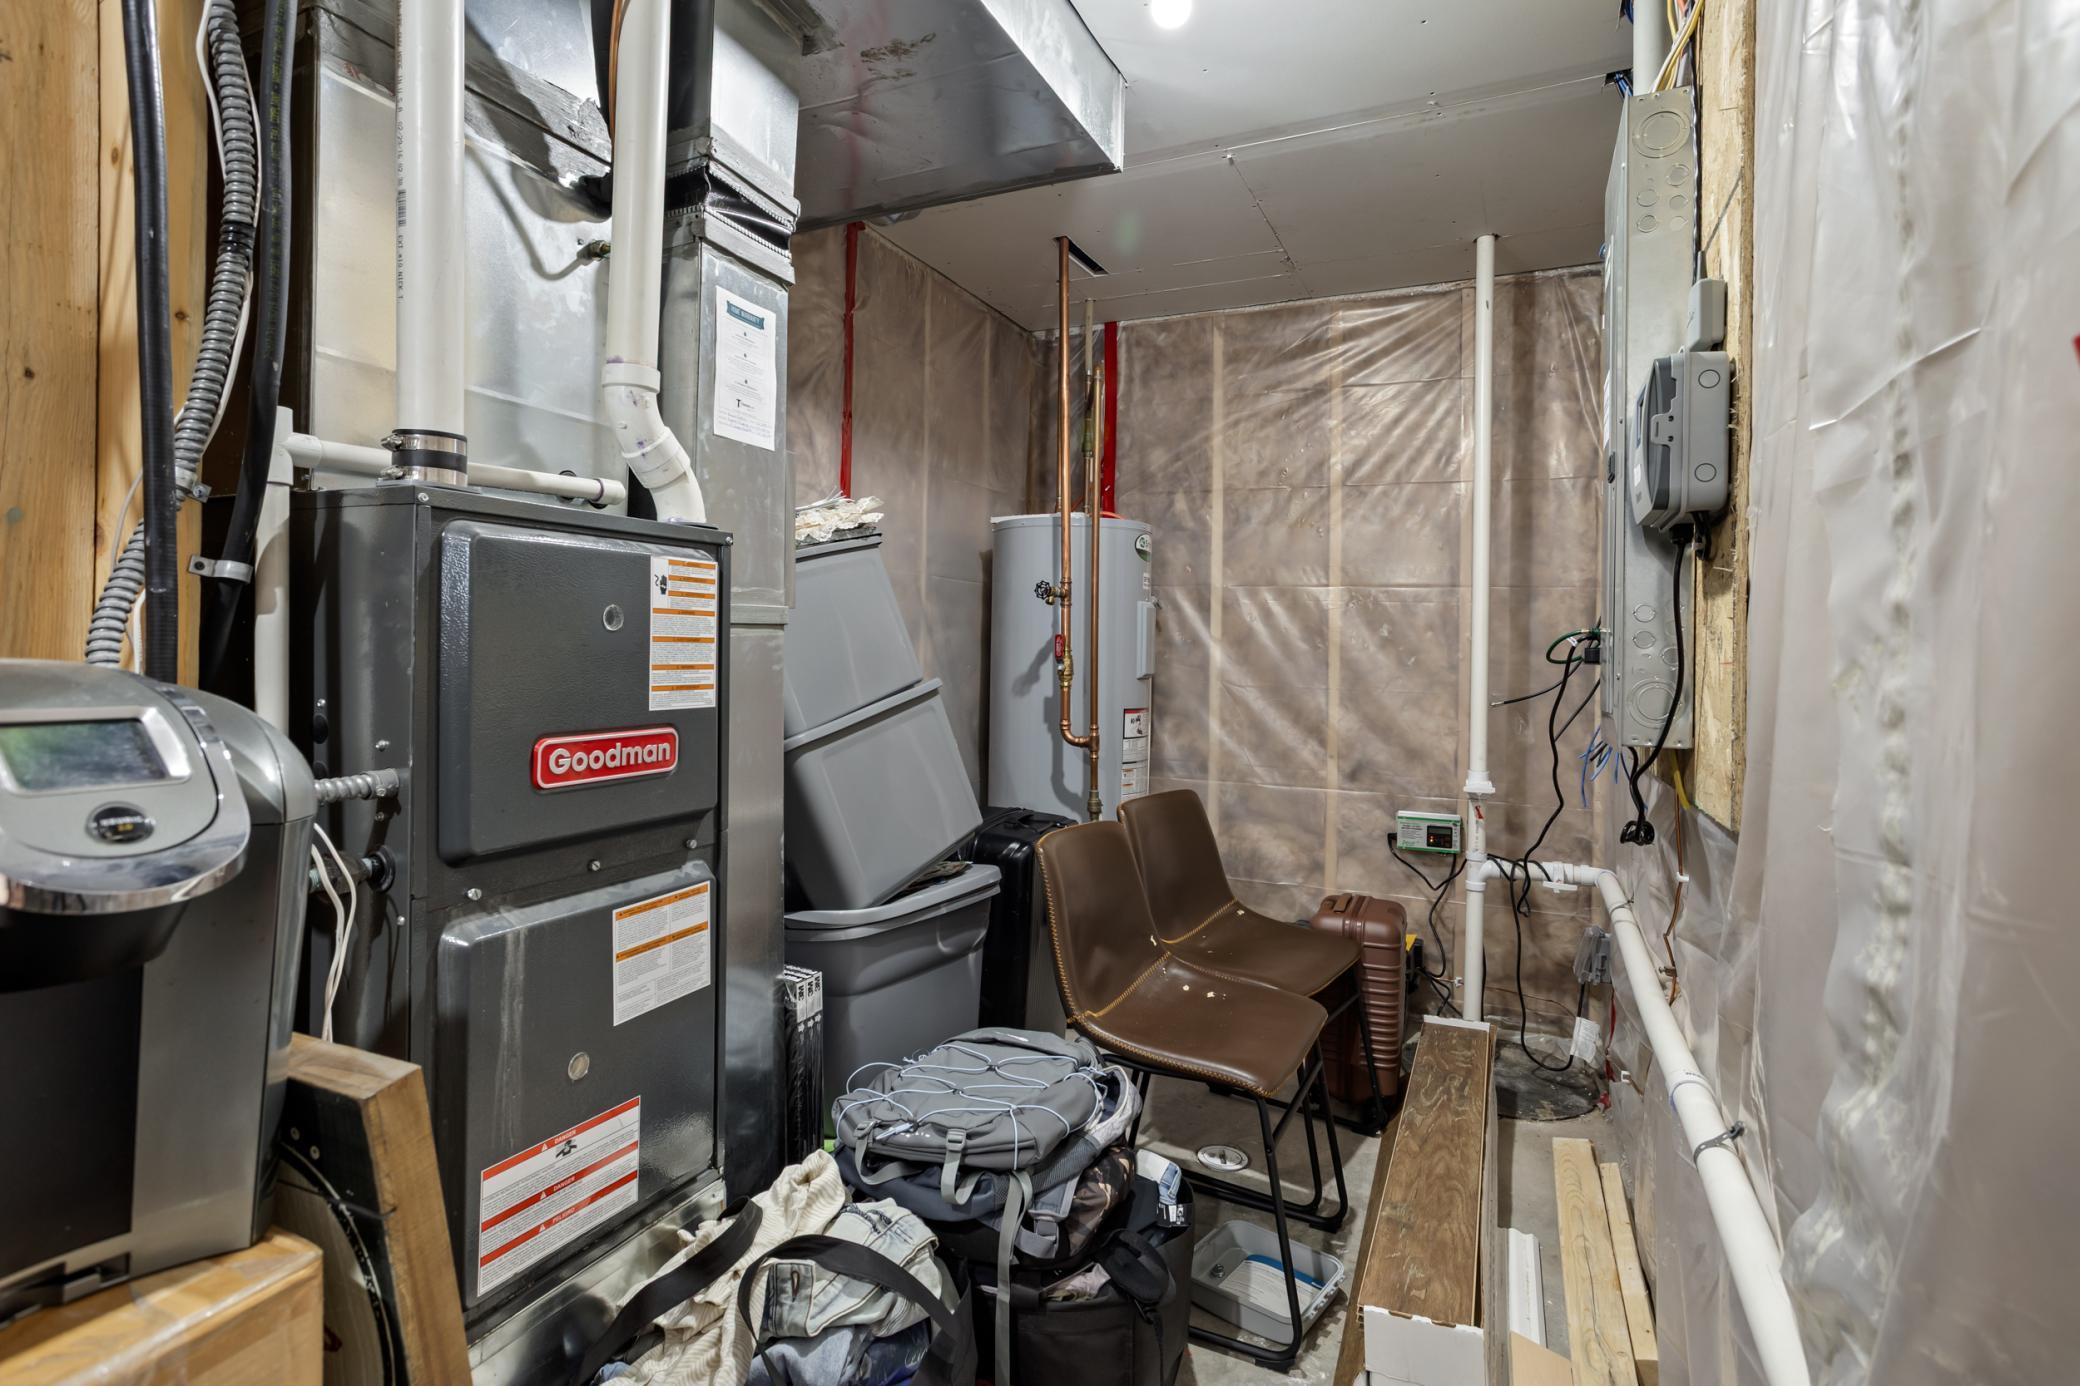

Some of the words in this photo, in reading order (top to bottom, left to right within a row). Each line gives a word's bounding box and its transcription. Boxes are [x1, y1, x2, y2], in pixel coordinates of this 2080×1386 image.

[549, 742, 671, 774] Goodman
[554, 1129, 577, 1144] DANGER
[553, 1176, 575, 1191] DANGER
